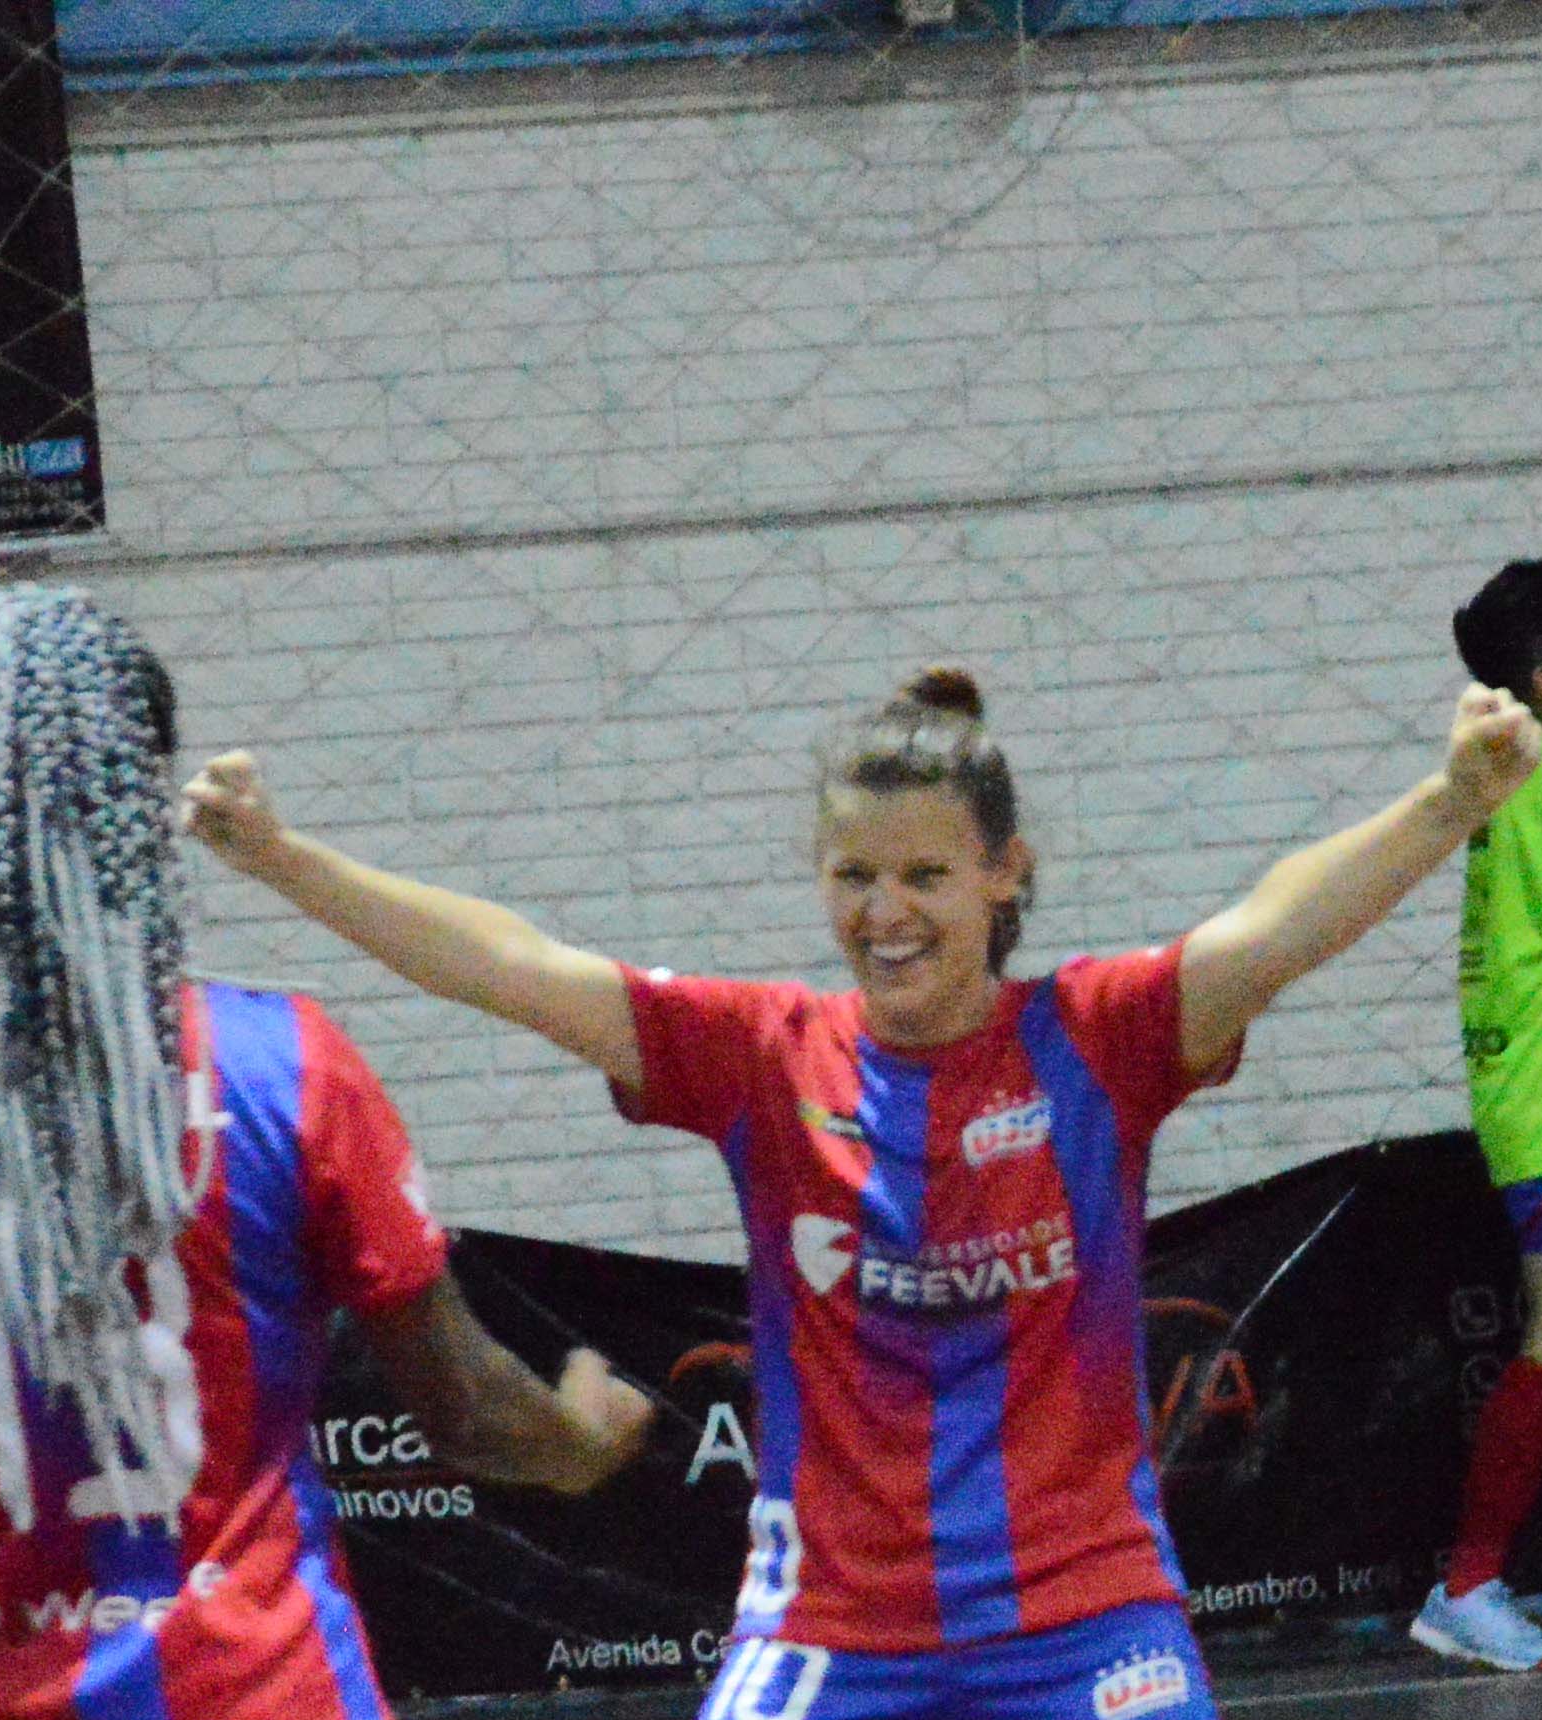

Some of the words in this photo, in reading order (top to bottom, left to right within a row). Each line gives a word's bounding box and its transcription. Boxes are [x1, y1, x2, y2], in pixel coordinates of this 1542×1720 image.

[860, 1235, 1077, 1306] FEEVALE
[308, 1412, 431, 1467] rca
[333, 1482, 476, 1521] inovos
[1187, 1571, 1329, 1616] etembro,
[546, 1633, 683, 1673] Avenida
